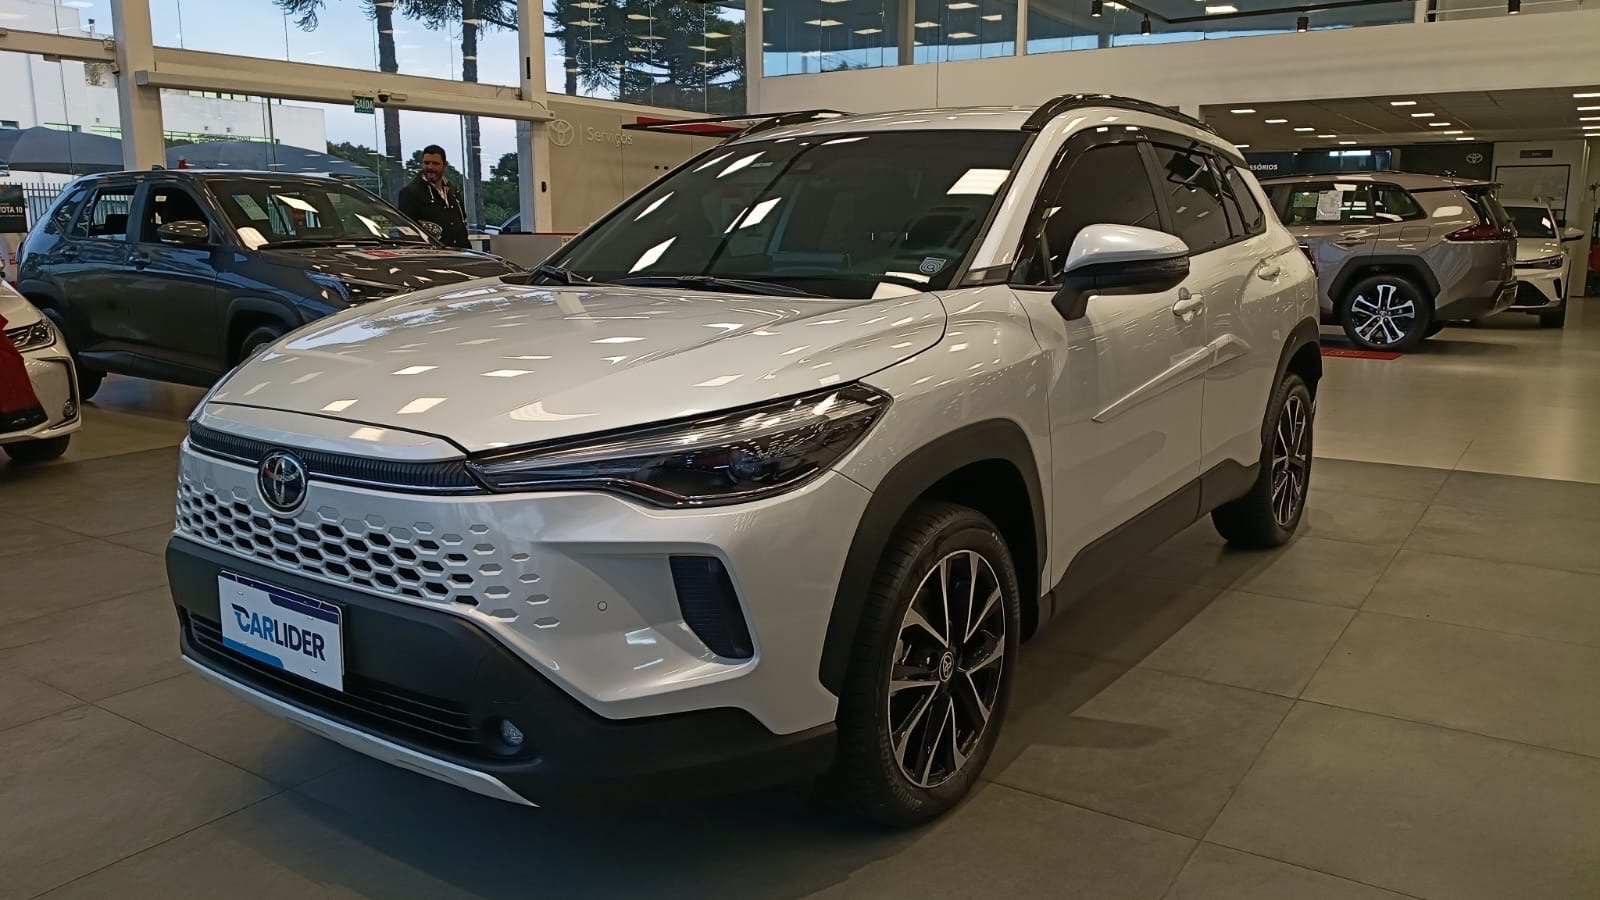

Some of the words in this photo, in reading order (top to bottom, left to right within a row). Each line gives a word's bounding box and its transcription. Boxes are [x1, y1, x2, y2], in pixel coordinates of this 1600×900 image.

[355, 96, 374, 110] SAÍDA
[587, 127, 633, 147] Serviços
[0, 205, 16, 214] OTA
[231, 603, 326, 661] CARLIDER
